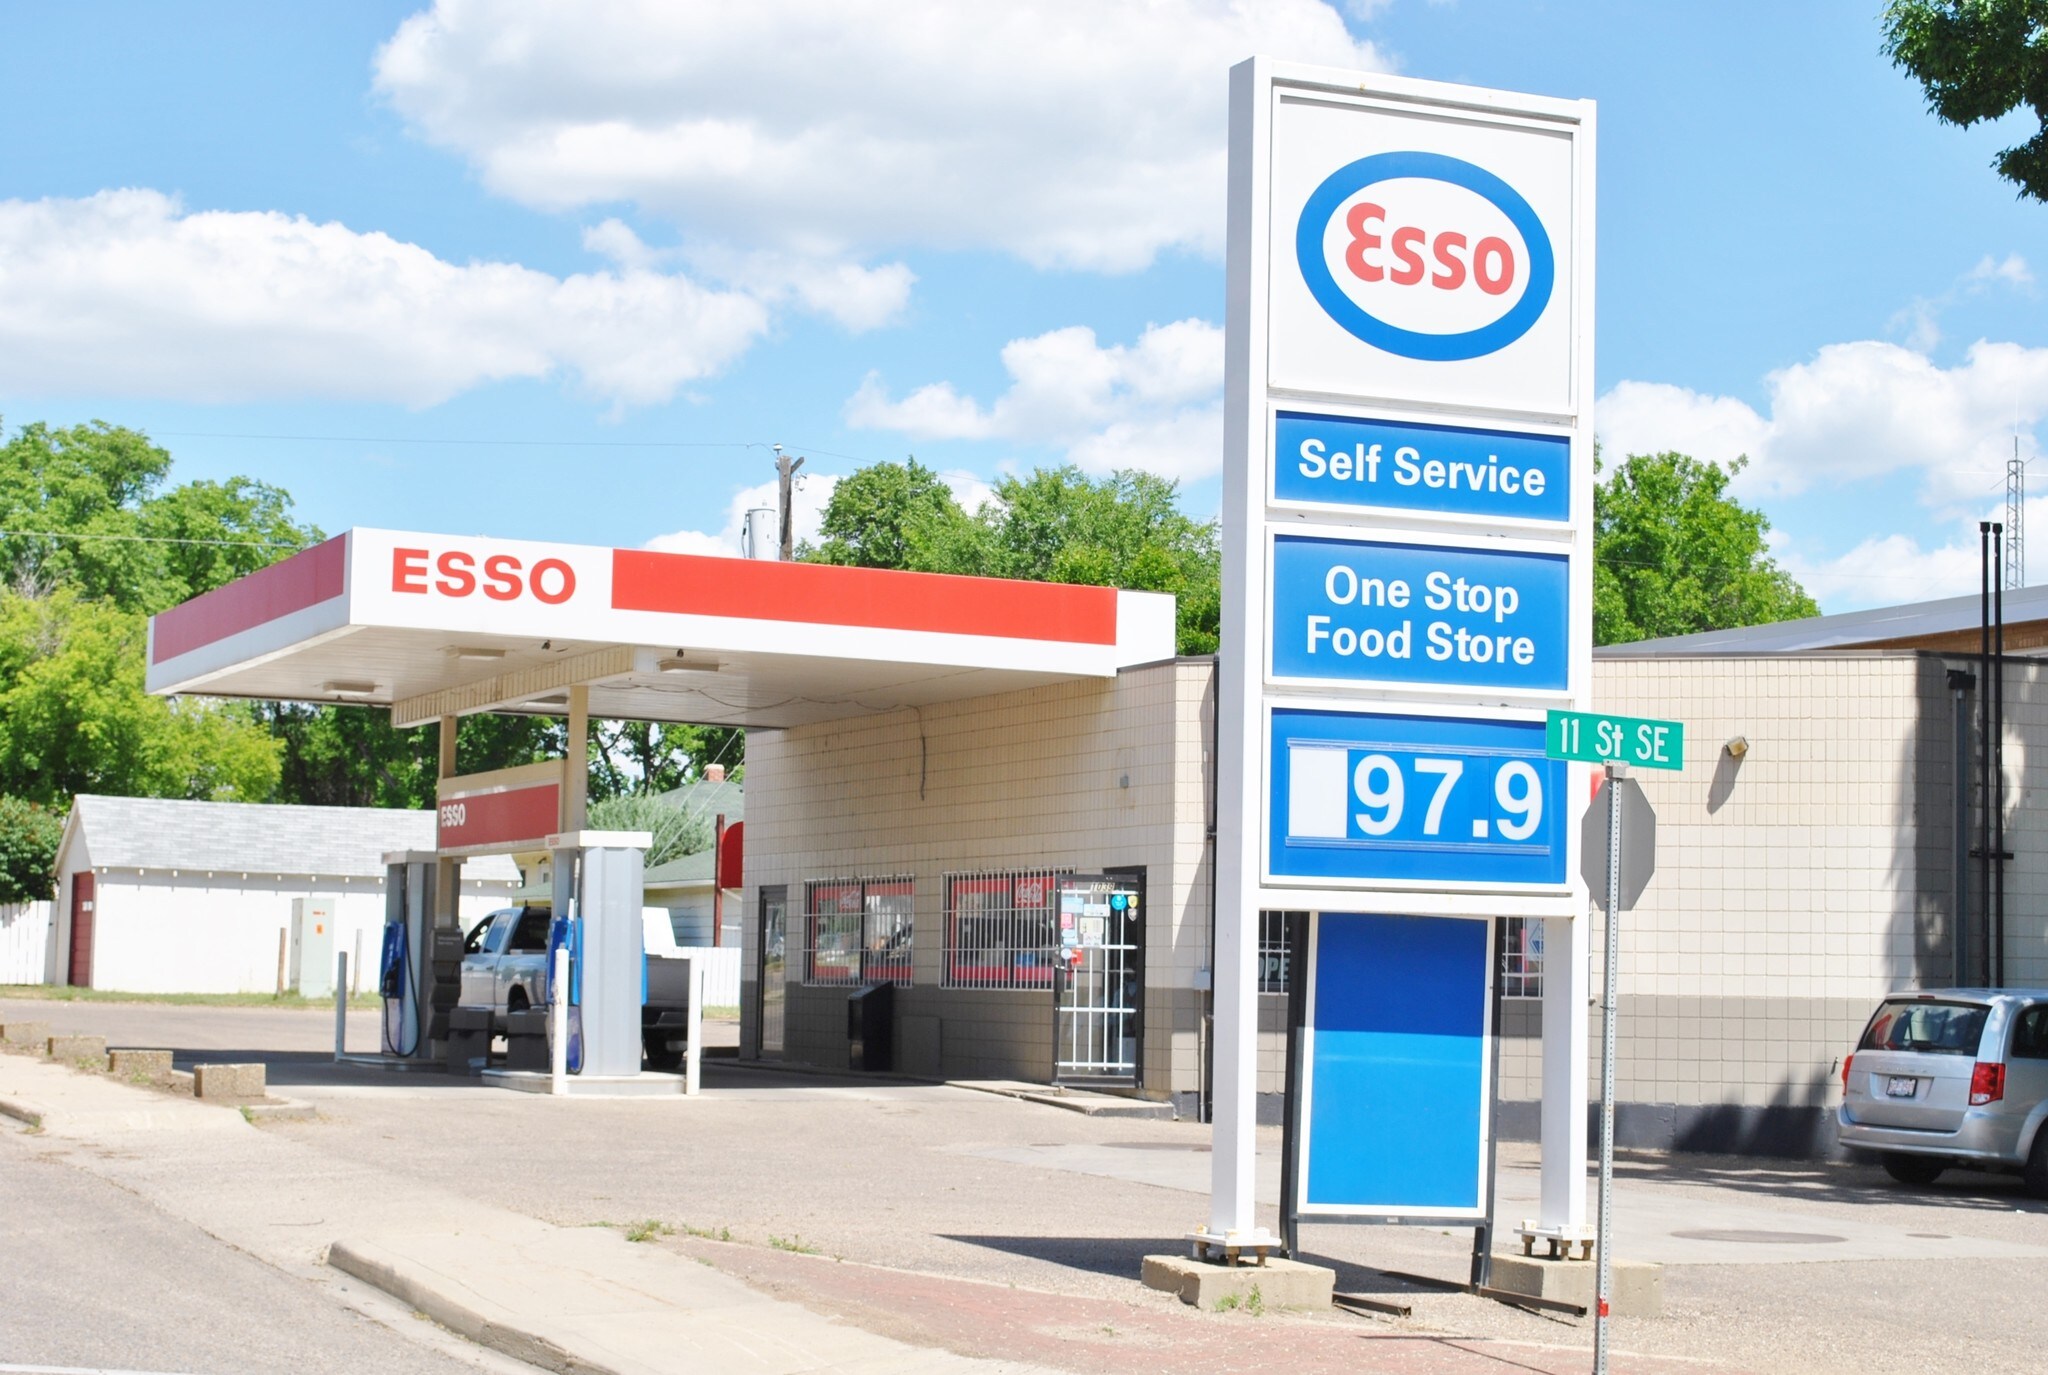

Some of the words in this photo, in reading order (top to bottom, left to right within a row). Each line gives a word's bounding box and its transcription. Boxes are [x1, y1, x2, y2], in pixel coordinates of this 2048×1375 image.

[1299, 438, 1382, 483] Self
[1393, 446, 1546, 496] Service
[392, 547, 576, 604] ESSO
[1324, 565, 1411, 609] One
[1424, 571, 1519, 623] Stop
[1306, 614, 1411, 659] Food
[1425, 621, 1535, 665] Store
[1560, 717, 1579, 754] 11
[1594, 719, 1624, 758] St
[1635, 723, 1670, 763] SE
[441, 803, 466, 828] ESSO
[1353, 754, 1543, 841] 97.9
